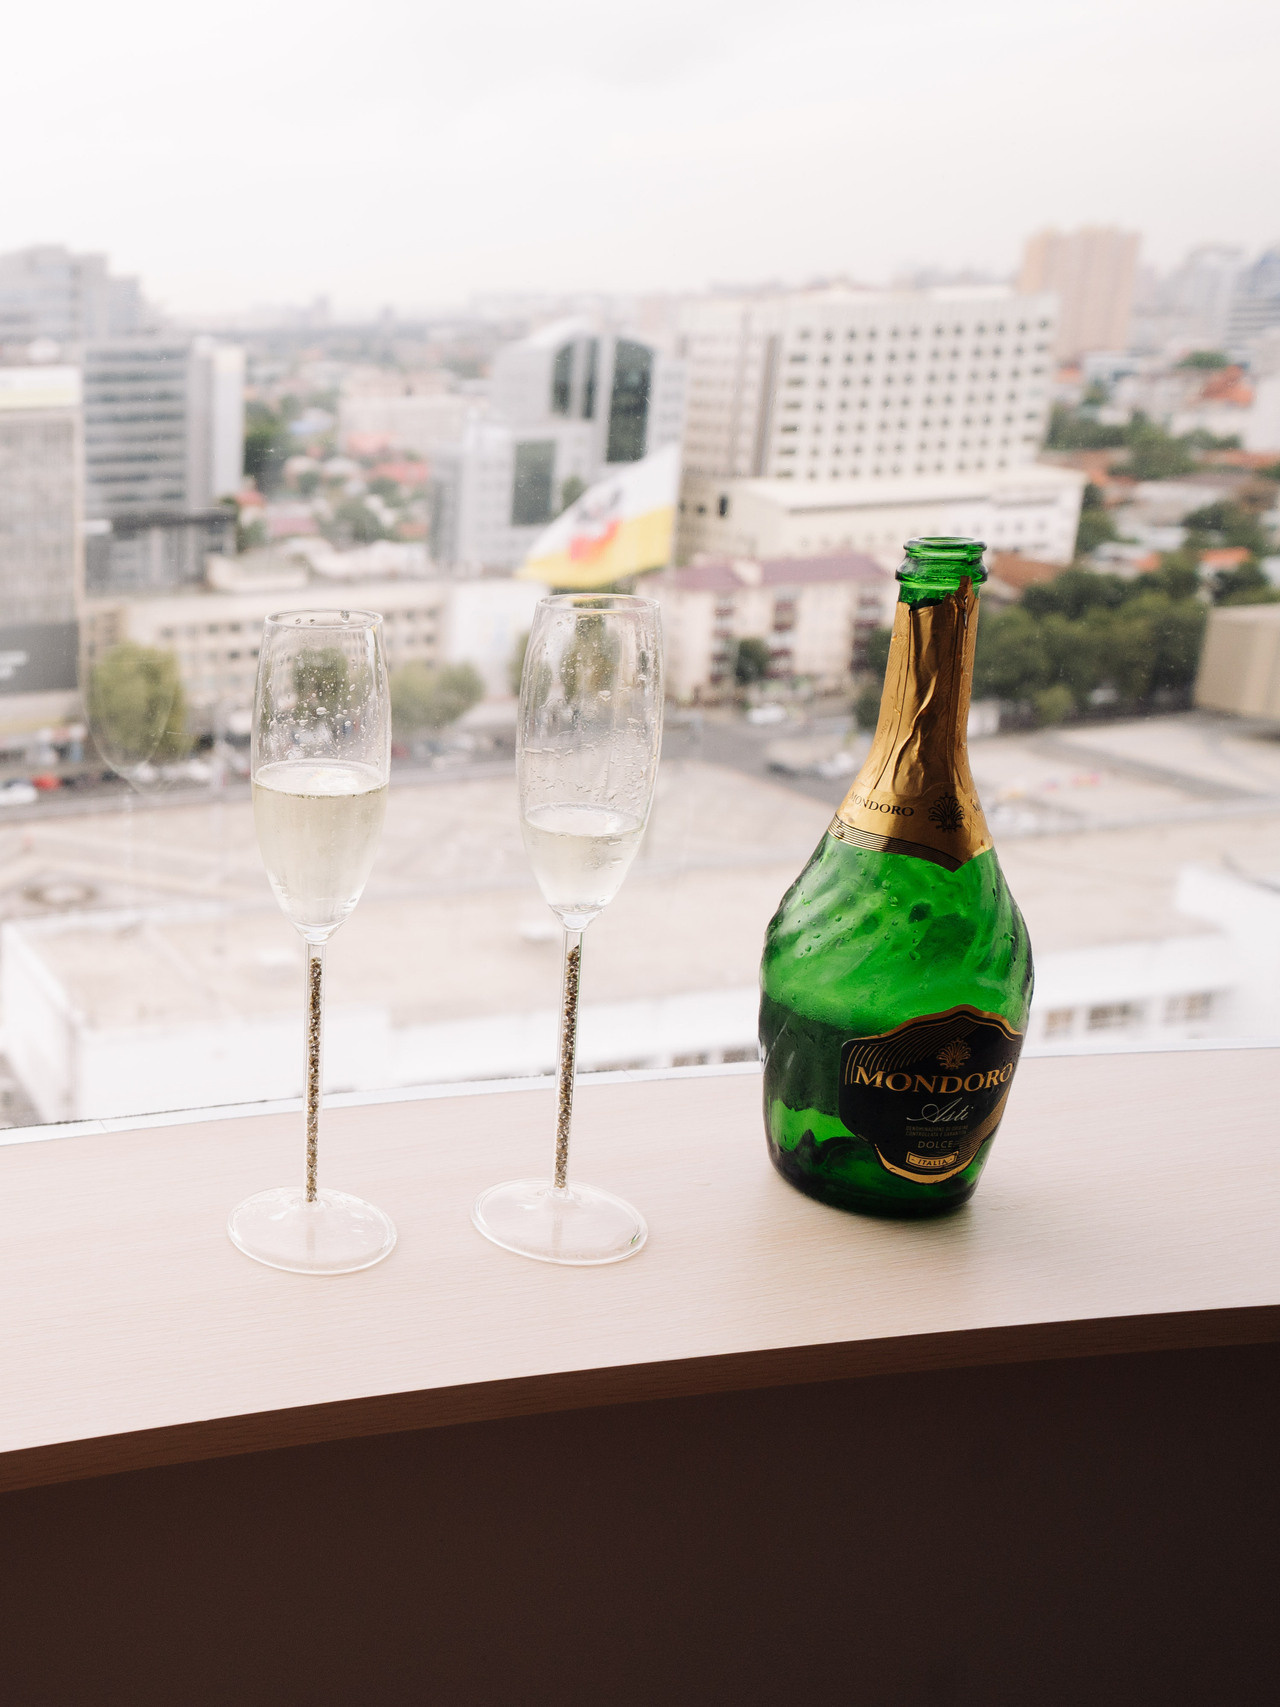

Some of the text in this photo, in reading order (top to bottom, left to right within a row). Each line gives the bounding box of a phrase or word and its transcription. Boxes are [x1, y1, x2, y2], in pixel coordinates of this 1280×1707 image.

[849, 791, 915, 817] MONDORO
[853, 1063, 1013, 1094] MONDORO
[906, 1097, 974, 1123] Asti
[917, 1140, 954, 1149] DOLCE
